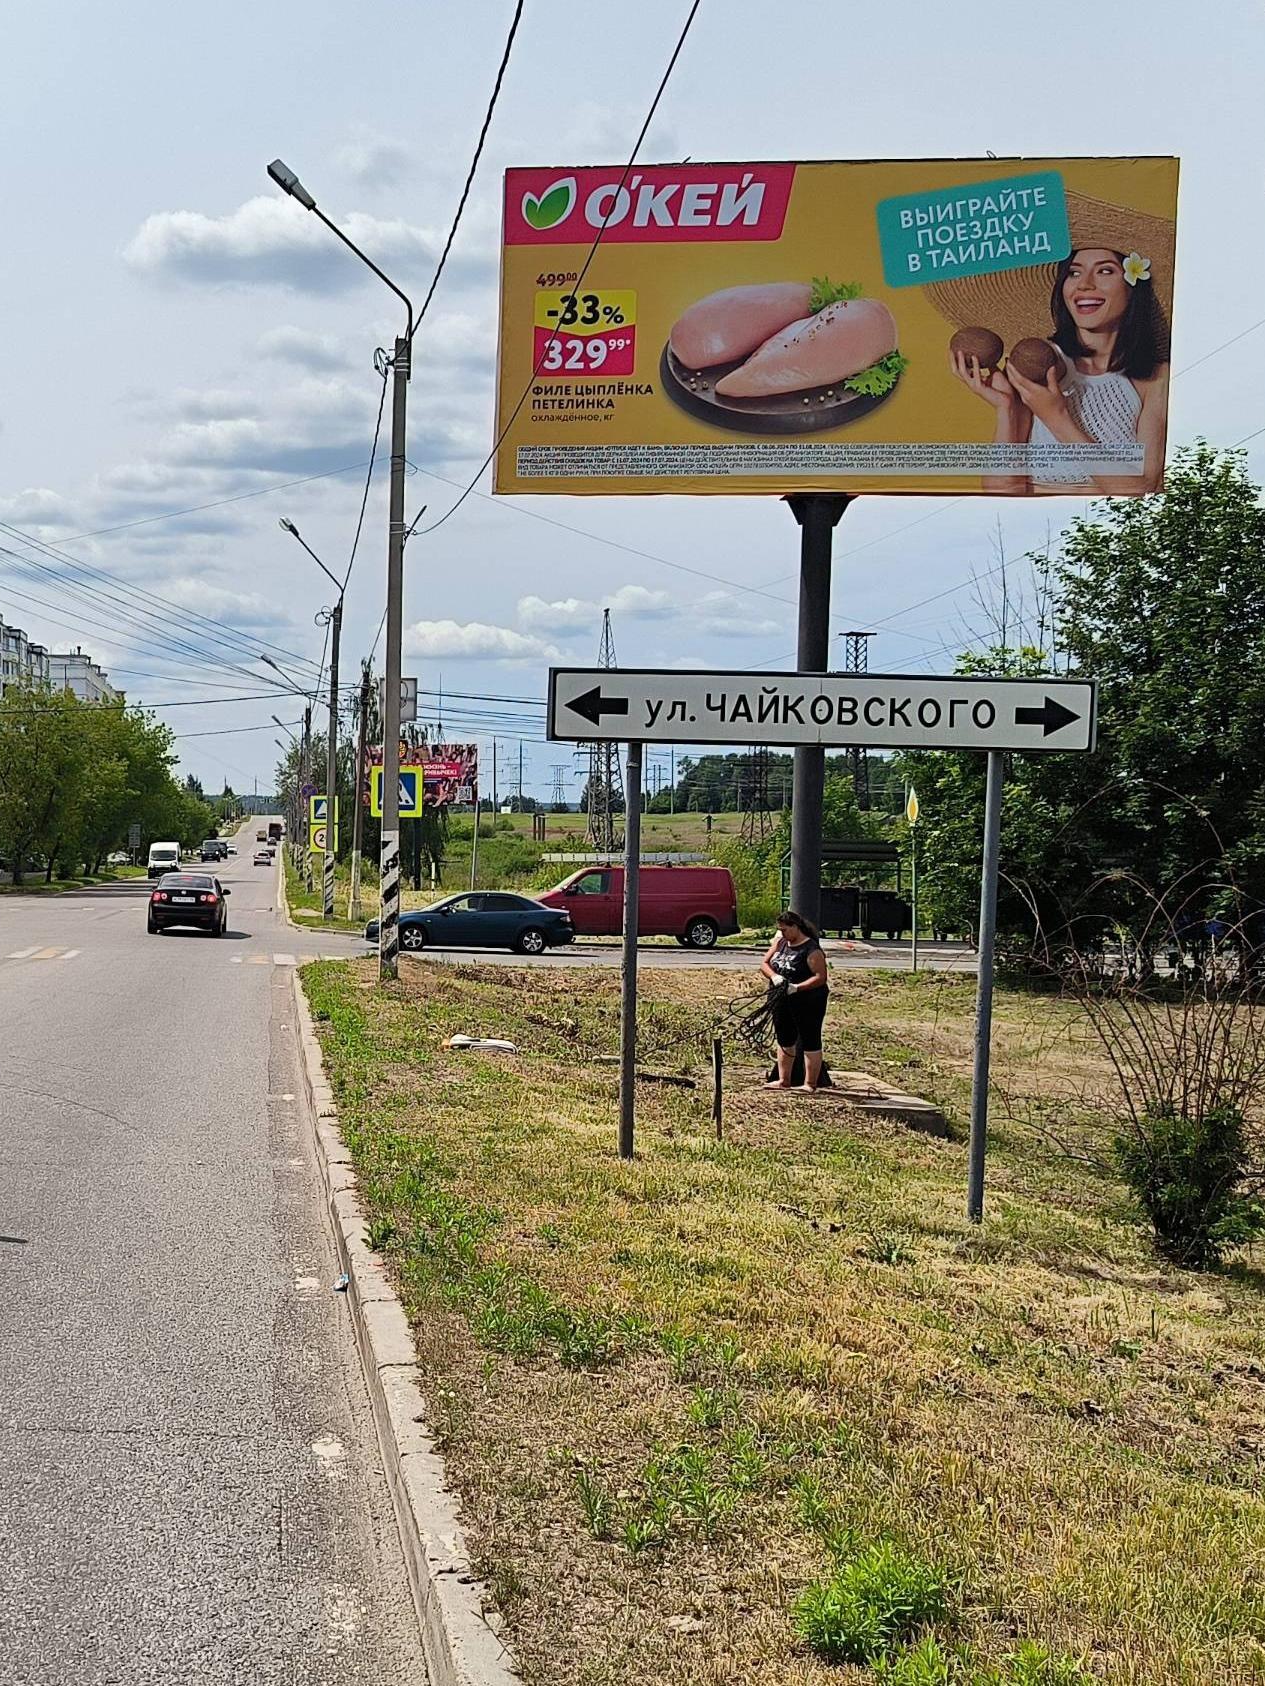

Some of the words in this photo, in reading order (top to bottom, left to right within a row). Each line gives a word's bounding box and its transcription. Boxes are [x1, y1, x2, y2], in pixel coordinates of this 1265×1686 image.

[899, 186, 1047, 229] ВЫИГРАЙТЕ
[917, 211, 1035, 248] ПОЕЗДКУ
[907, 253, 922, 272] В
[926, 231, 1051, 269] ТАИЛАНД
[532, 384, 572, 396] ФИЛЕ
[574, 382, 654, 397] ЦЫПЛЁНКА
[532, 398, 615, 410] ПЕТЕЛИНКА
[531, 413, 602, 422] охлаждённое,
[603, 413, 615, 421] кг
[645, 699, 696, 729] ул.
[705, 686, 996, 730] ЧАЙКОВСКОГО
